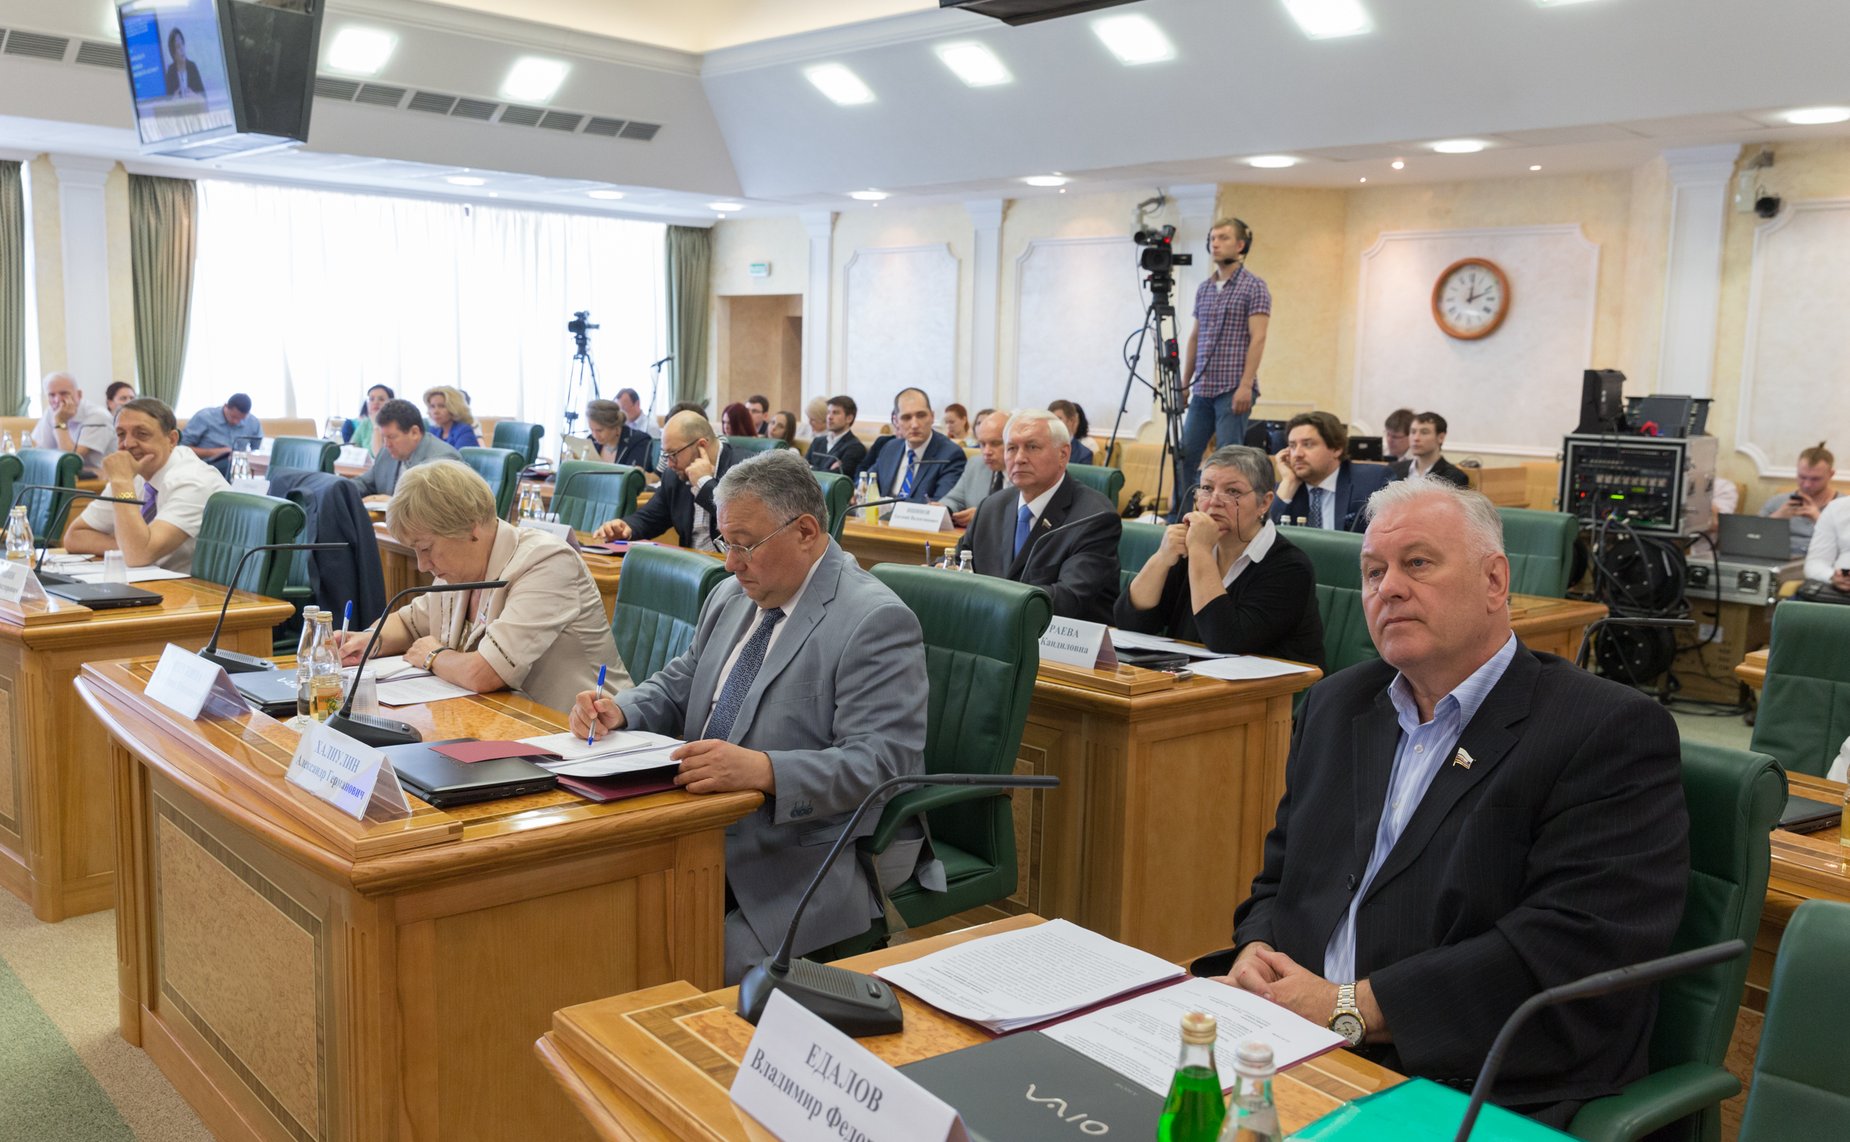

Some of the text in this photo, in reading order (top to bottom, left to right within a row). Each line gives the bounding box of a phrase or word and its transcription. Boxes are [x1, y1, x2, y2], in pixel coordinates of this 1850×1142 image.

[1048, 624, 1079, 639] РАЕВА
[750, 1047, 875, 1142] Владимир Федо
[805, 1042, 883, 1113] ЕДАЛОВ
[1026, 1083, 1109, 1135] VAIO
